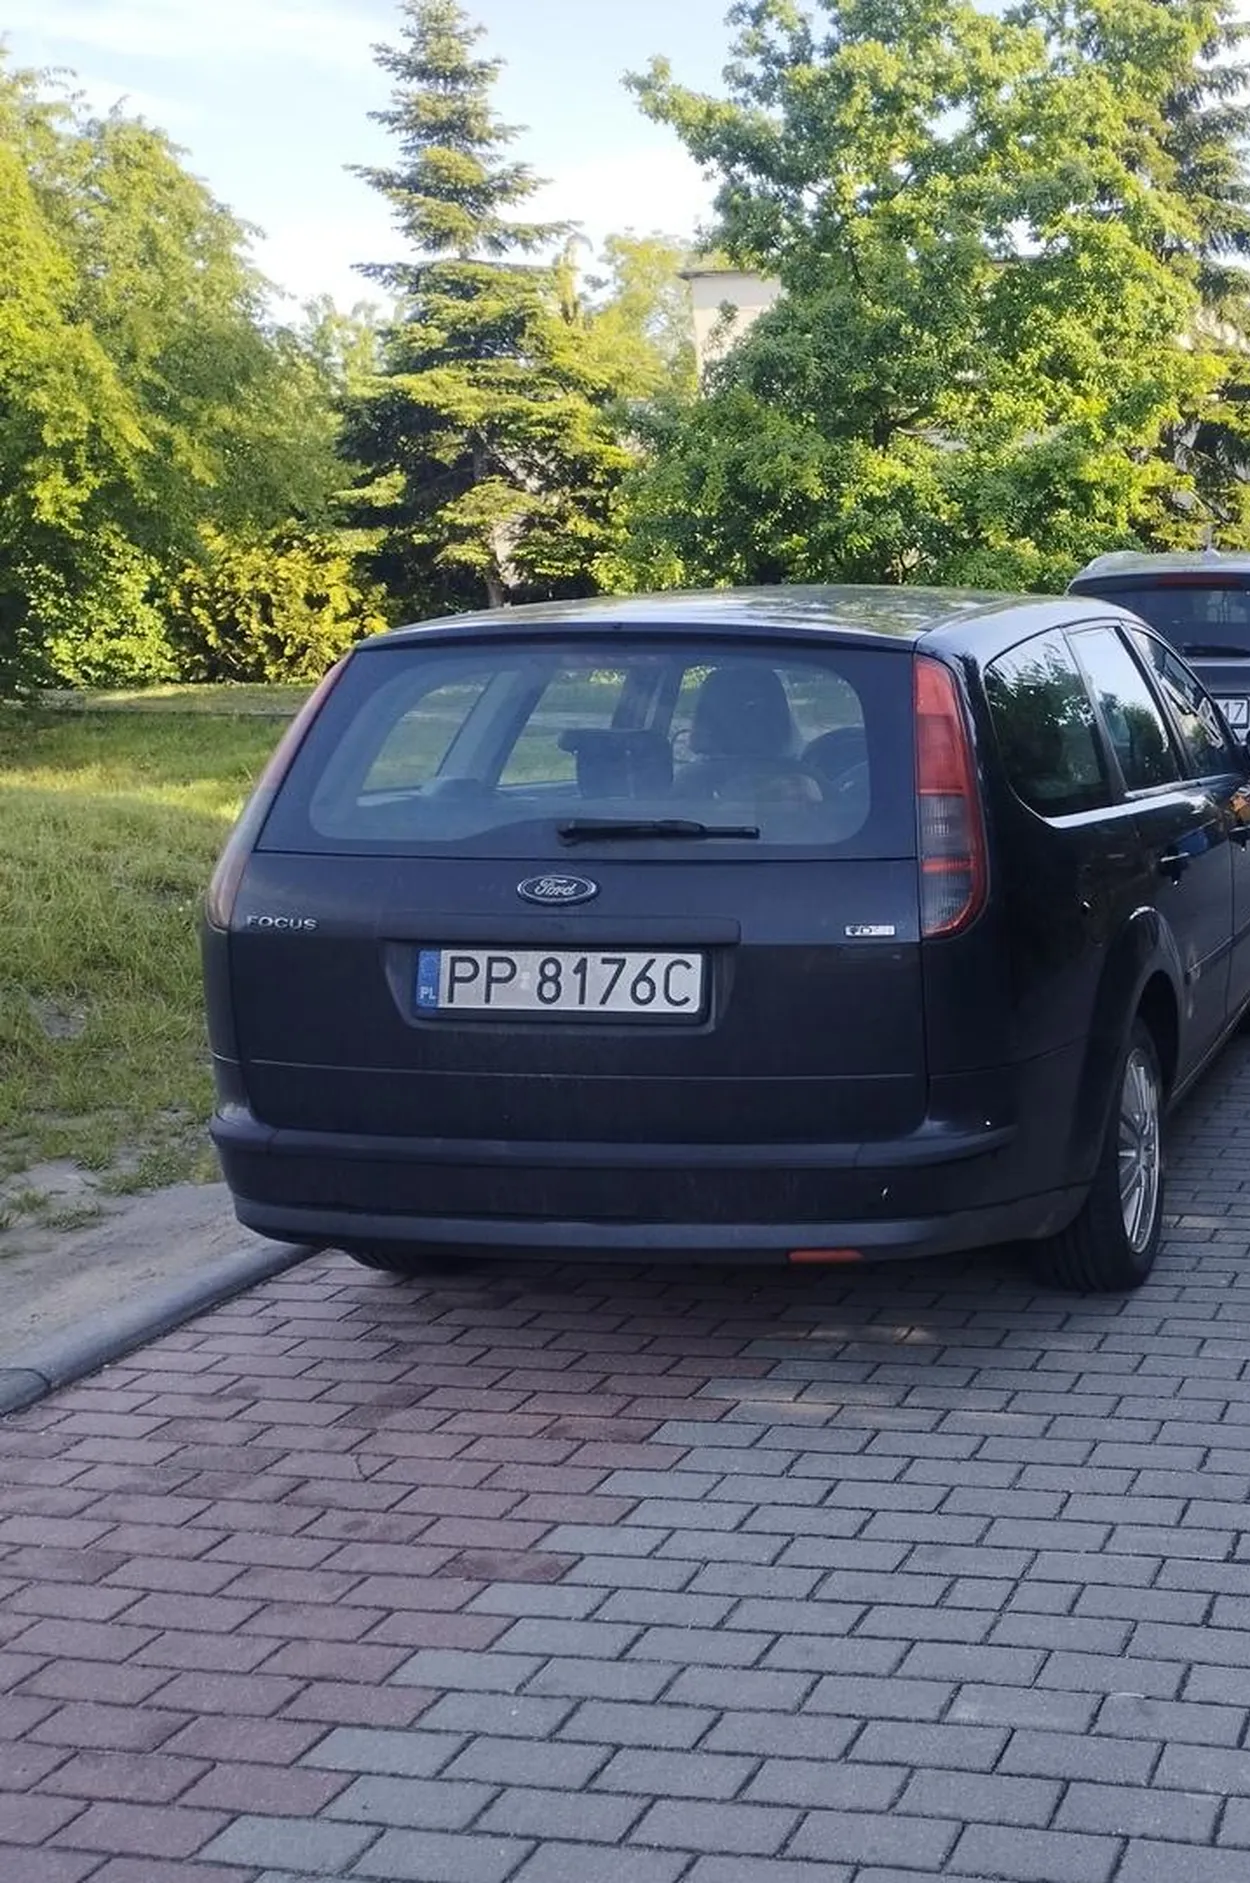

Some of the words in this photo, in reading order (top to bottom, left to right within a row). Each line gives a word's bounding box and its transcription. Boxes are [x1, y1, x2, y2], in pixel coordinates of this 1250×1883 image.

[1223, 702, 1245, 721] 17
[535, 878, 577, 895] Ford
[247, 915, 318, 930] FOCUS
[448, 956, 518, 1004] PP
[536, 957, 693, 1006] 8176C
[420, 986, 436, 999] PL
